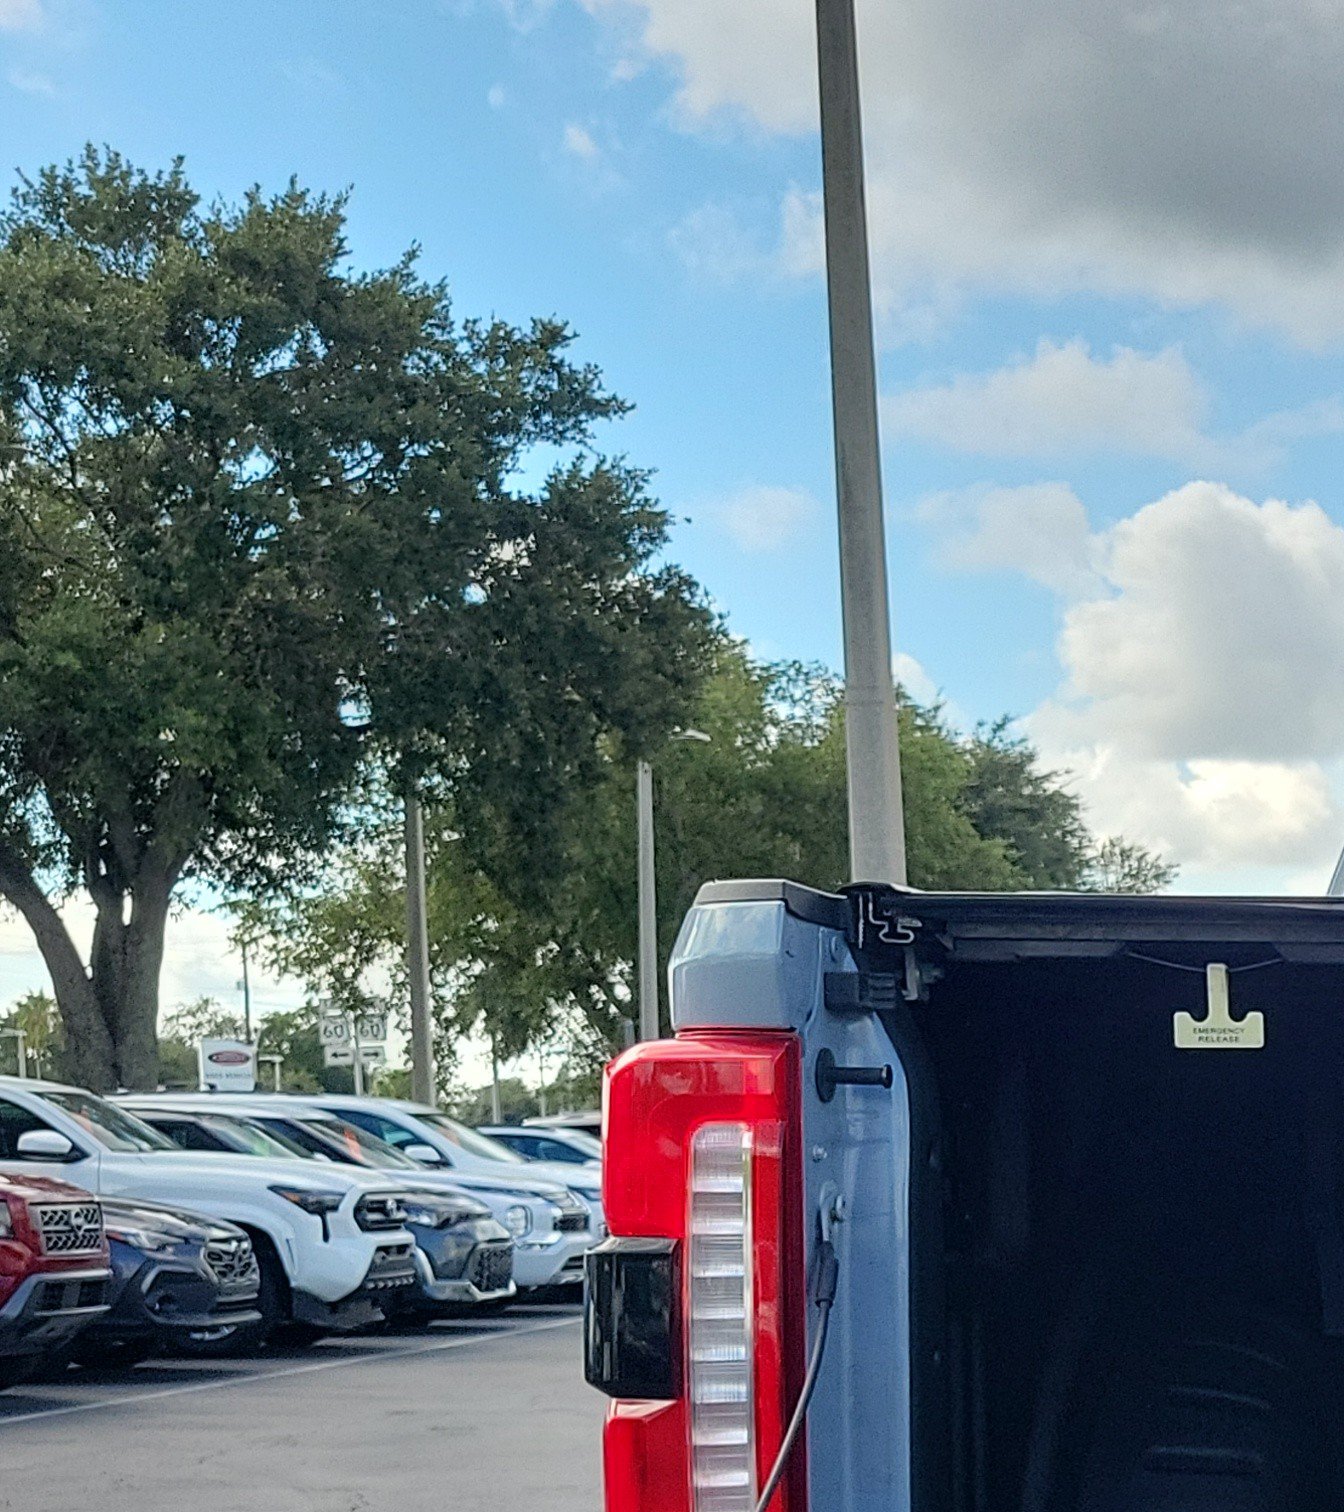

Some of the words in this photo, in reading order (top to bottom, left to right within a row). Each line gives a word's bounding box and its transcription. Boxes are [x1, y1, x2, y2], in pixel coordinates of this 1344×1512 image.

[323, 1025, 344, 1039] 60
[360, 1024, 380, 1038] 60
[1193, 1027, 1245, 1035] EMERGENCY
